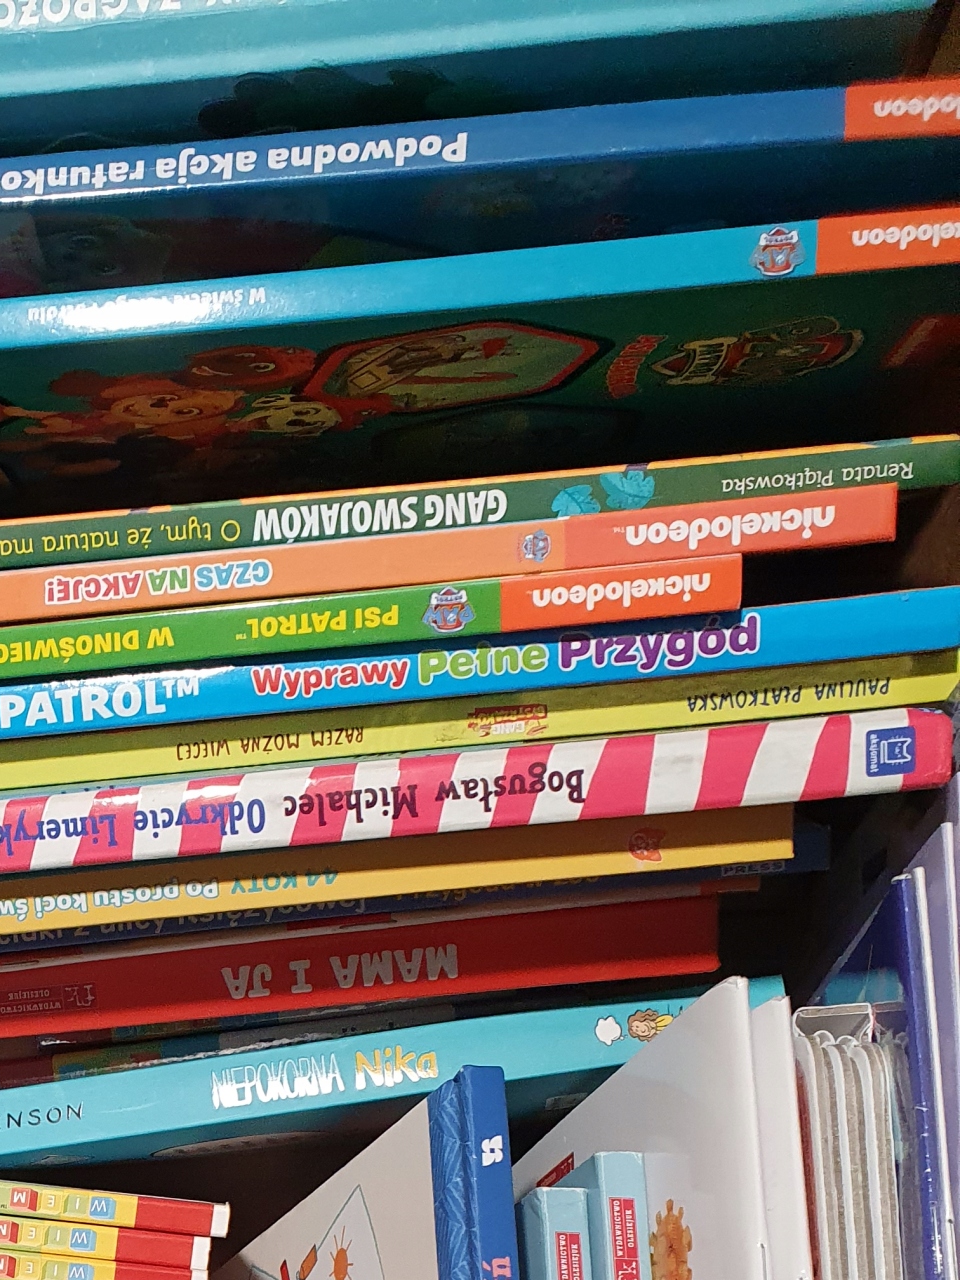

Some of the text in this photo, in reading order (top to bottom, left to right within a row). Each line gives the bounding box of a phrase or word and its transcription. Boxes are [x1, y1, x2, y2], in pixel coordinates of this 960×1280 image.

[267, 133, 468, 163] Podwodna
[156, 148, 255, 183] akcja
[249, 287, 266, 305] W
[721, 461, 914, 494] Renata Piątkowska
[159, 516, 211, 543] tym,
[220, 519, 241, 542] O
[252, 489, 508, 543] GANG SWOJAKÓW
[625, 505, 835, 549] nickelodeon
[42, 530, 118, 554] natura
[125, 525, 152, 549] że
[43, 559, 273, 605] CZAS NA AKCJĘ!
[531, 572, 712, 613] nickelodeon
[350, 603, 400, 627] PSI
[421, 603, 476, 626] PAW
[148, 626, 174, 649] W
[250, 656, 411, 698] Wyprawy
[416, 642, 550, 685] Pełne
[558, 613, 761, 670] Przygód
[686, 676, 891, 714] PAULINA PŁATKOWSKA
[175, 725, 365, 761] RAZEM MOŻNA WIĘCEJ
[869, 732, 879, 773] aksjomat
[283, 783, 418, 826] Michalec
[436, 763, 586, 813] Bogusław
[134, 799, 265, 848] Odkrycie
[94, 878, 178, 908] prostu
[185, 878, 219, 900] Po
[230, 871, 298, 895] KOTY
[304, 866, 338, 889] 44
[33, 891, 87, 920] koci
[221, 944, 459, 1000] MAMA I JA
[0, 1001, 61, 1014] WYDAWNICTWO
[8, 989, 50, 1000] OLESIEJUK
[211, 1053, 345, 1109] NIEPOKORNA
[355, 1045, 439, 1091] Nika
[613, 1200, 624, 1256] WYDAWNICTWO
[625, 1209, 635, 1248] OLESIEJUK
